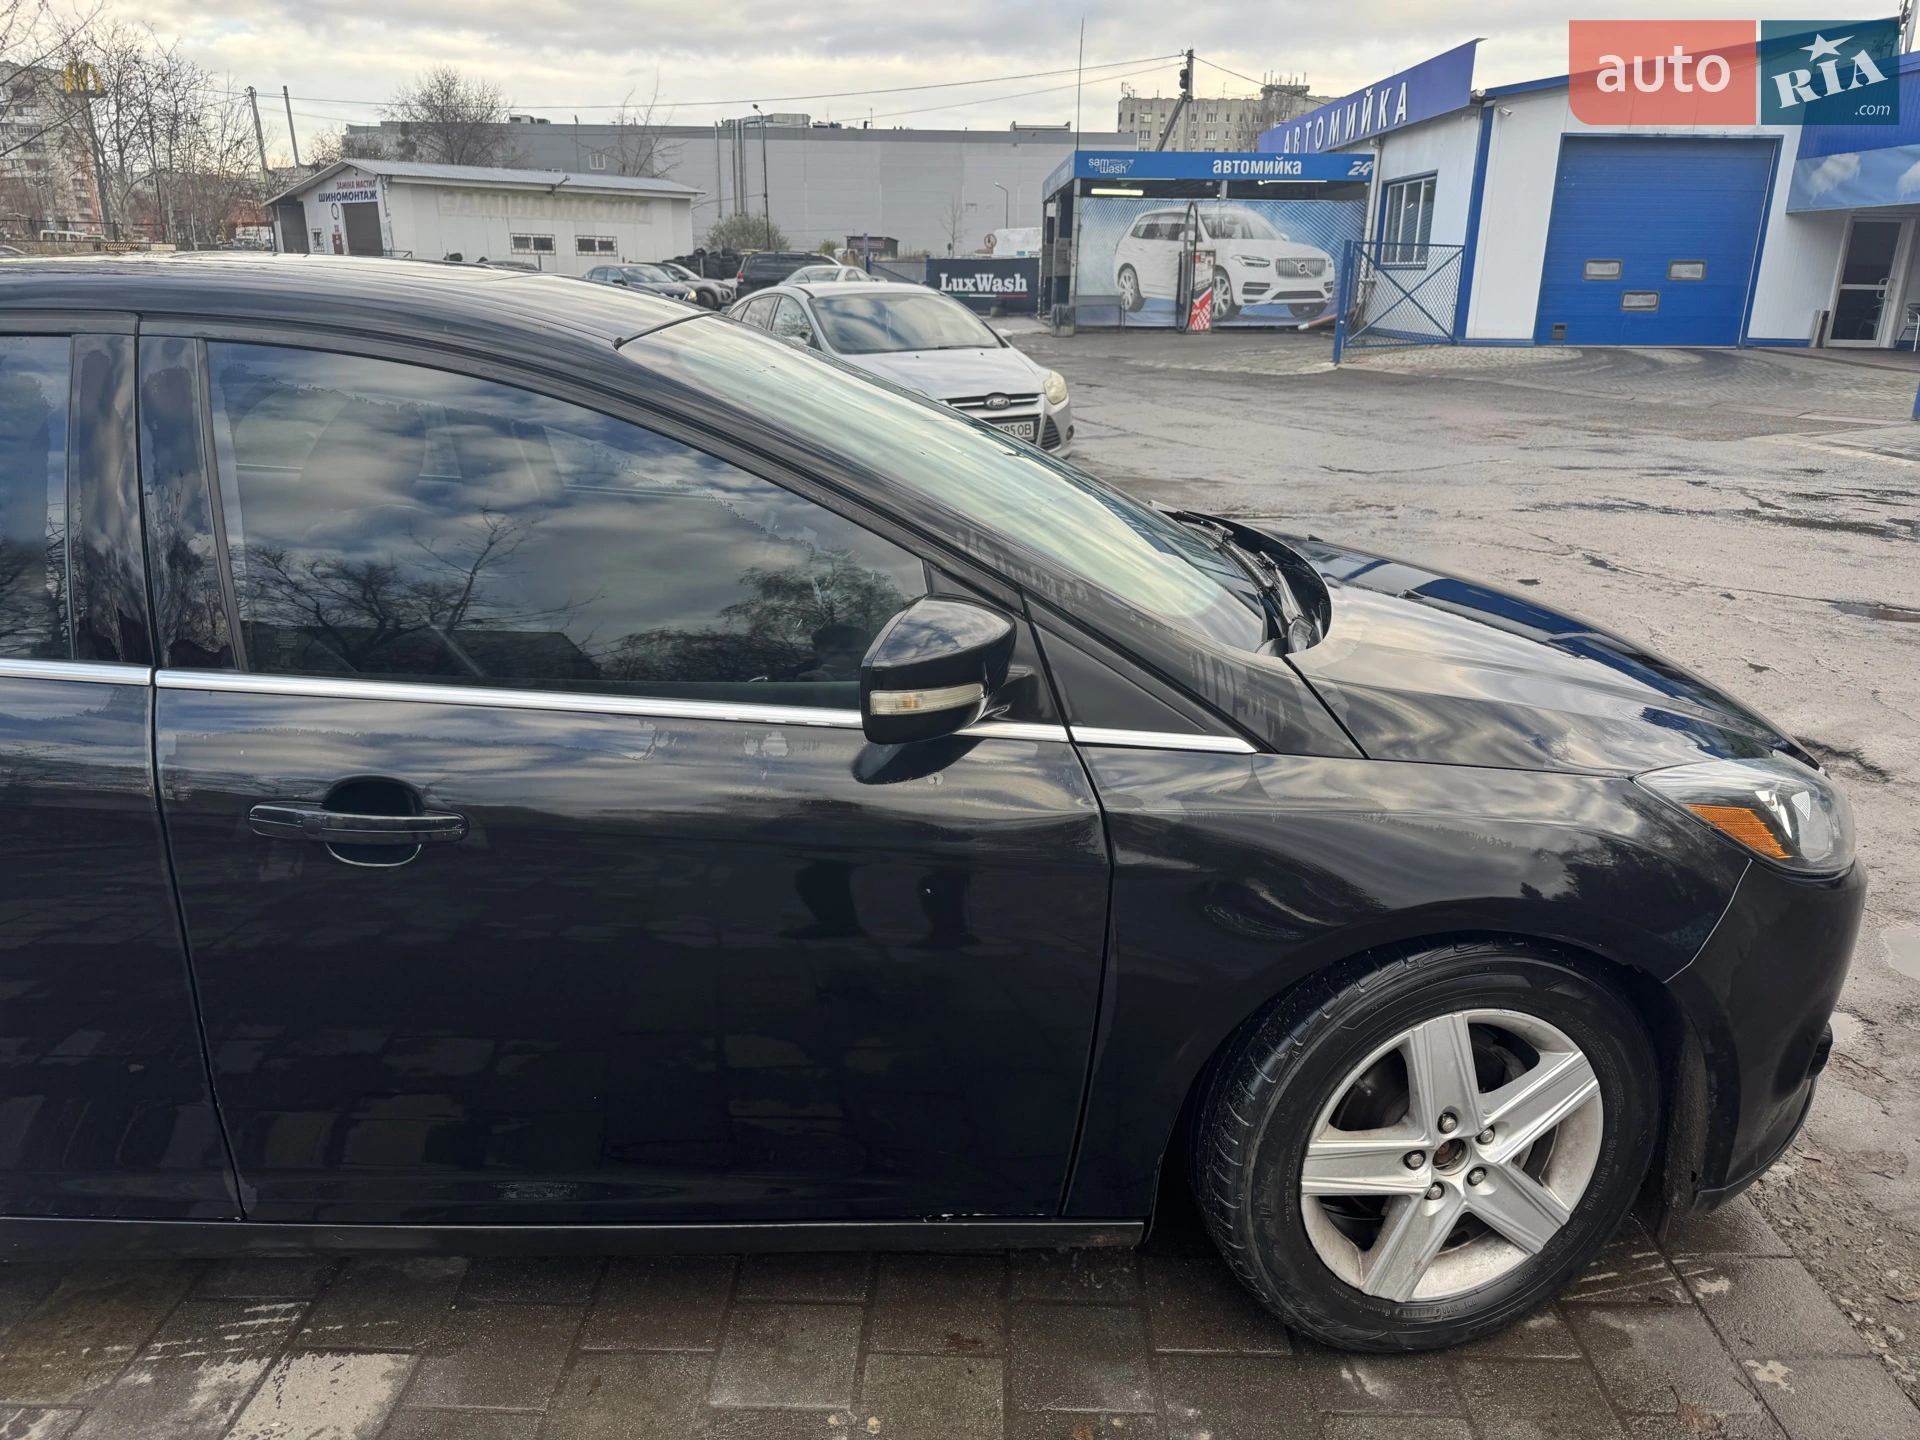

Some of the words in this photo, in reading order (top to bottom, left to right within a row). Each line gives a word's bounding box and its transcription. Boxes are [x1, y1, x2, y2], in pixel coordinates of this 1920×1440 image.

[1284, 82, 1407, 153] АВТОМИЙКА
[1088, 158, 1109, 167] sam
[1099, 164, 1127, 174] wash
[1212, 156, 1302, 175] автомийка
[318, 190, 378, 203] ШИНОМОНТАЖ
[939, 273, 1028, 293] LuxWash
